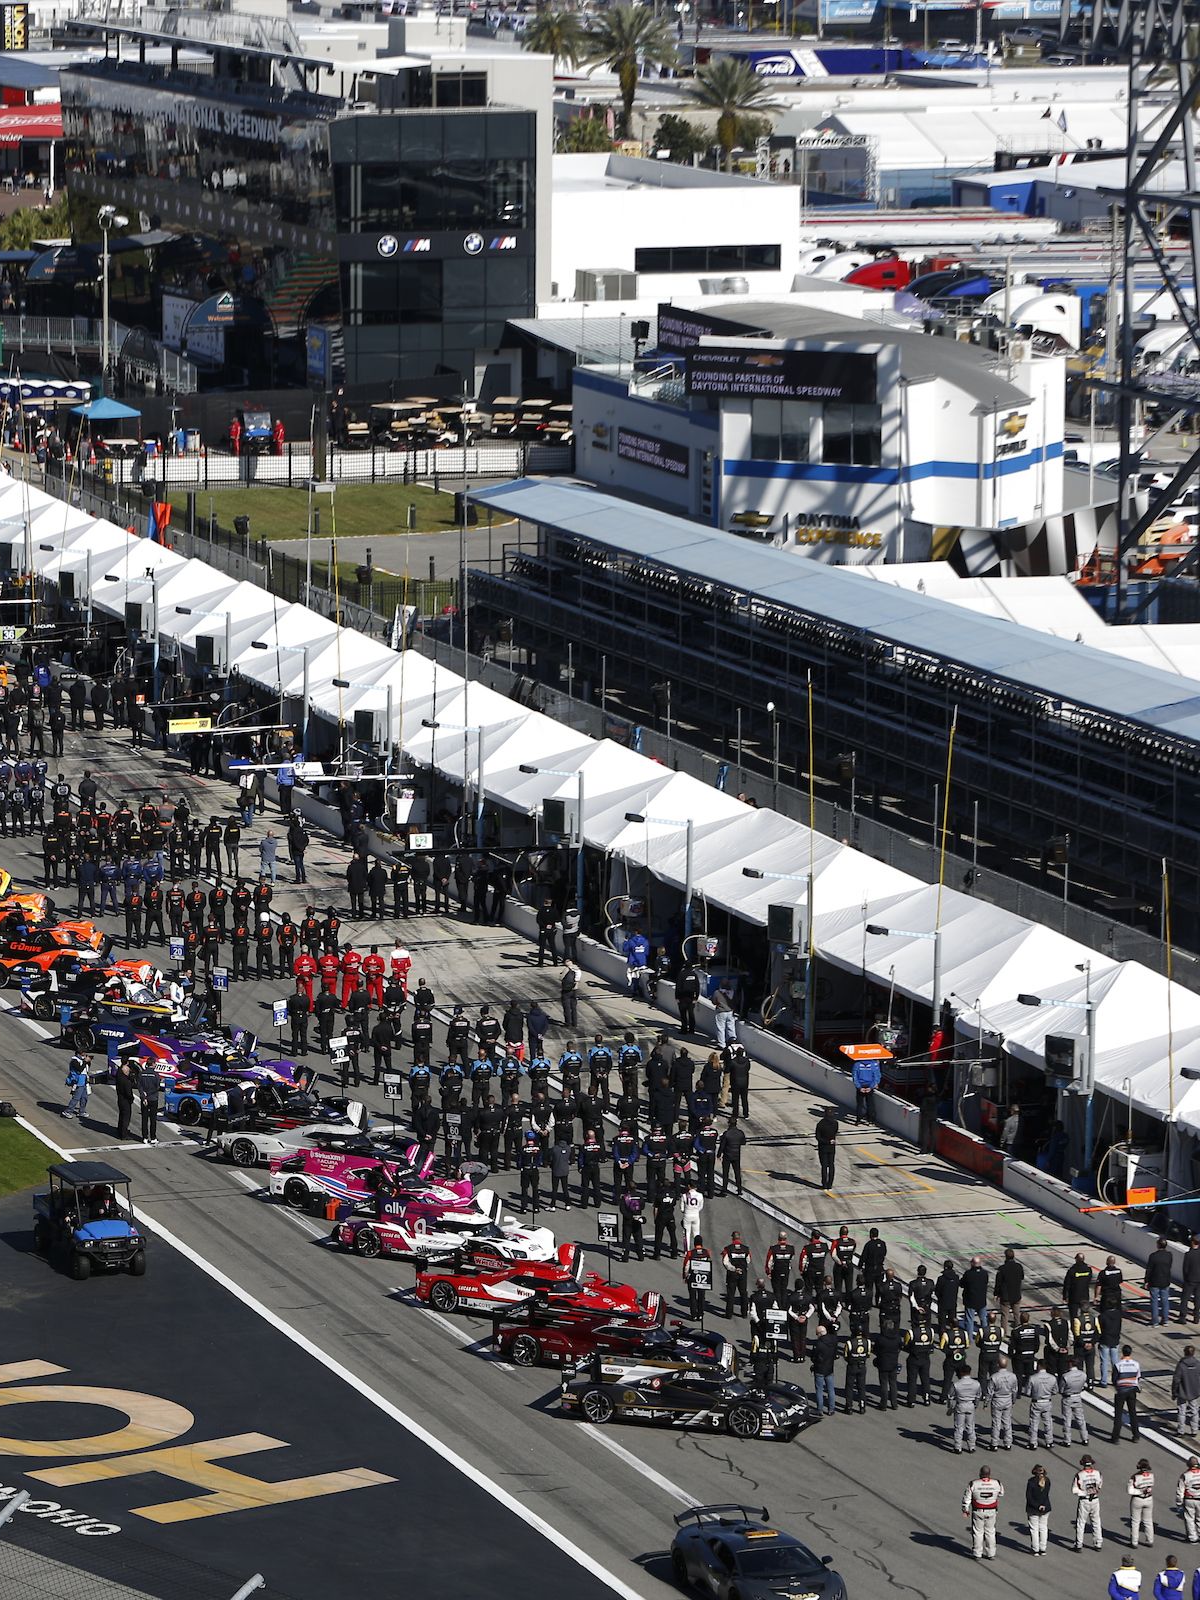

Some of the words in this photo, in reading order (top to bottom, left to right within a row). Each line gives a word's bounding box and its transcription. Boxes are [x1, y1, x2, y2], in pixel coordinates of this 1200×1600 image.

[14, 5, 25, 49] UNOH
[224, 111, 282, 143] SPEEDWAY
[693, 354, 740, 363] CHEVROLET
[691, 372, 733, 382] FOUNDING
[734, 373, 772, 383] PARTNER
[773, 375, 785, 384] OF
[691, 381, 729, 392] DAYTONA
[730, 383, 795, 395] INTERNATIONAL
[796, 386, 842, 397] SPEEDWAY
[797, 513, 860, 529] DAYTONA
[795, 529, 882, 548] EXPERIENCE
[3, 630, 15, 640] 36
[294, 762, 306, 770] 57
[173, 947, 183, 956] 20
[216, 978, 225, 987] 11
[276, 1011, 286, 1021] 52
[334, 1048, 345, 1059] 10
[843, 1045, 855, 1054] 70
[387, 1085, 398, 1094] 01
[449, 1126, 459, 1136] 60
[384, 1201, 407, 1218] ally
[602, 1227, 614, 1237] 31
[474, 1257, 505, 1269] WHELEN
[695, 1273, 708, 1285] 02
[773, 1323, 781, 1333] 5
[711, 1415, 720, 1427] 5
[17, 1500, 122, 1536] OHIO
